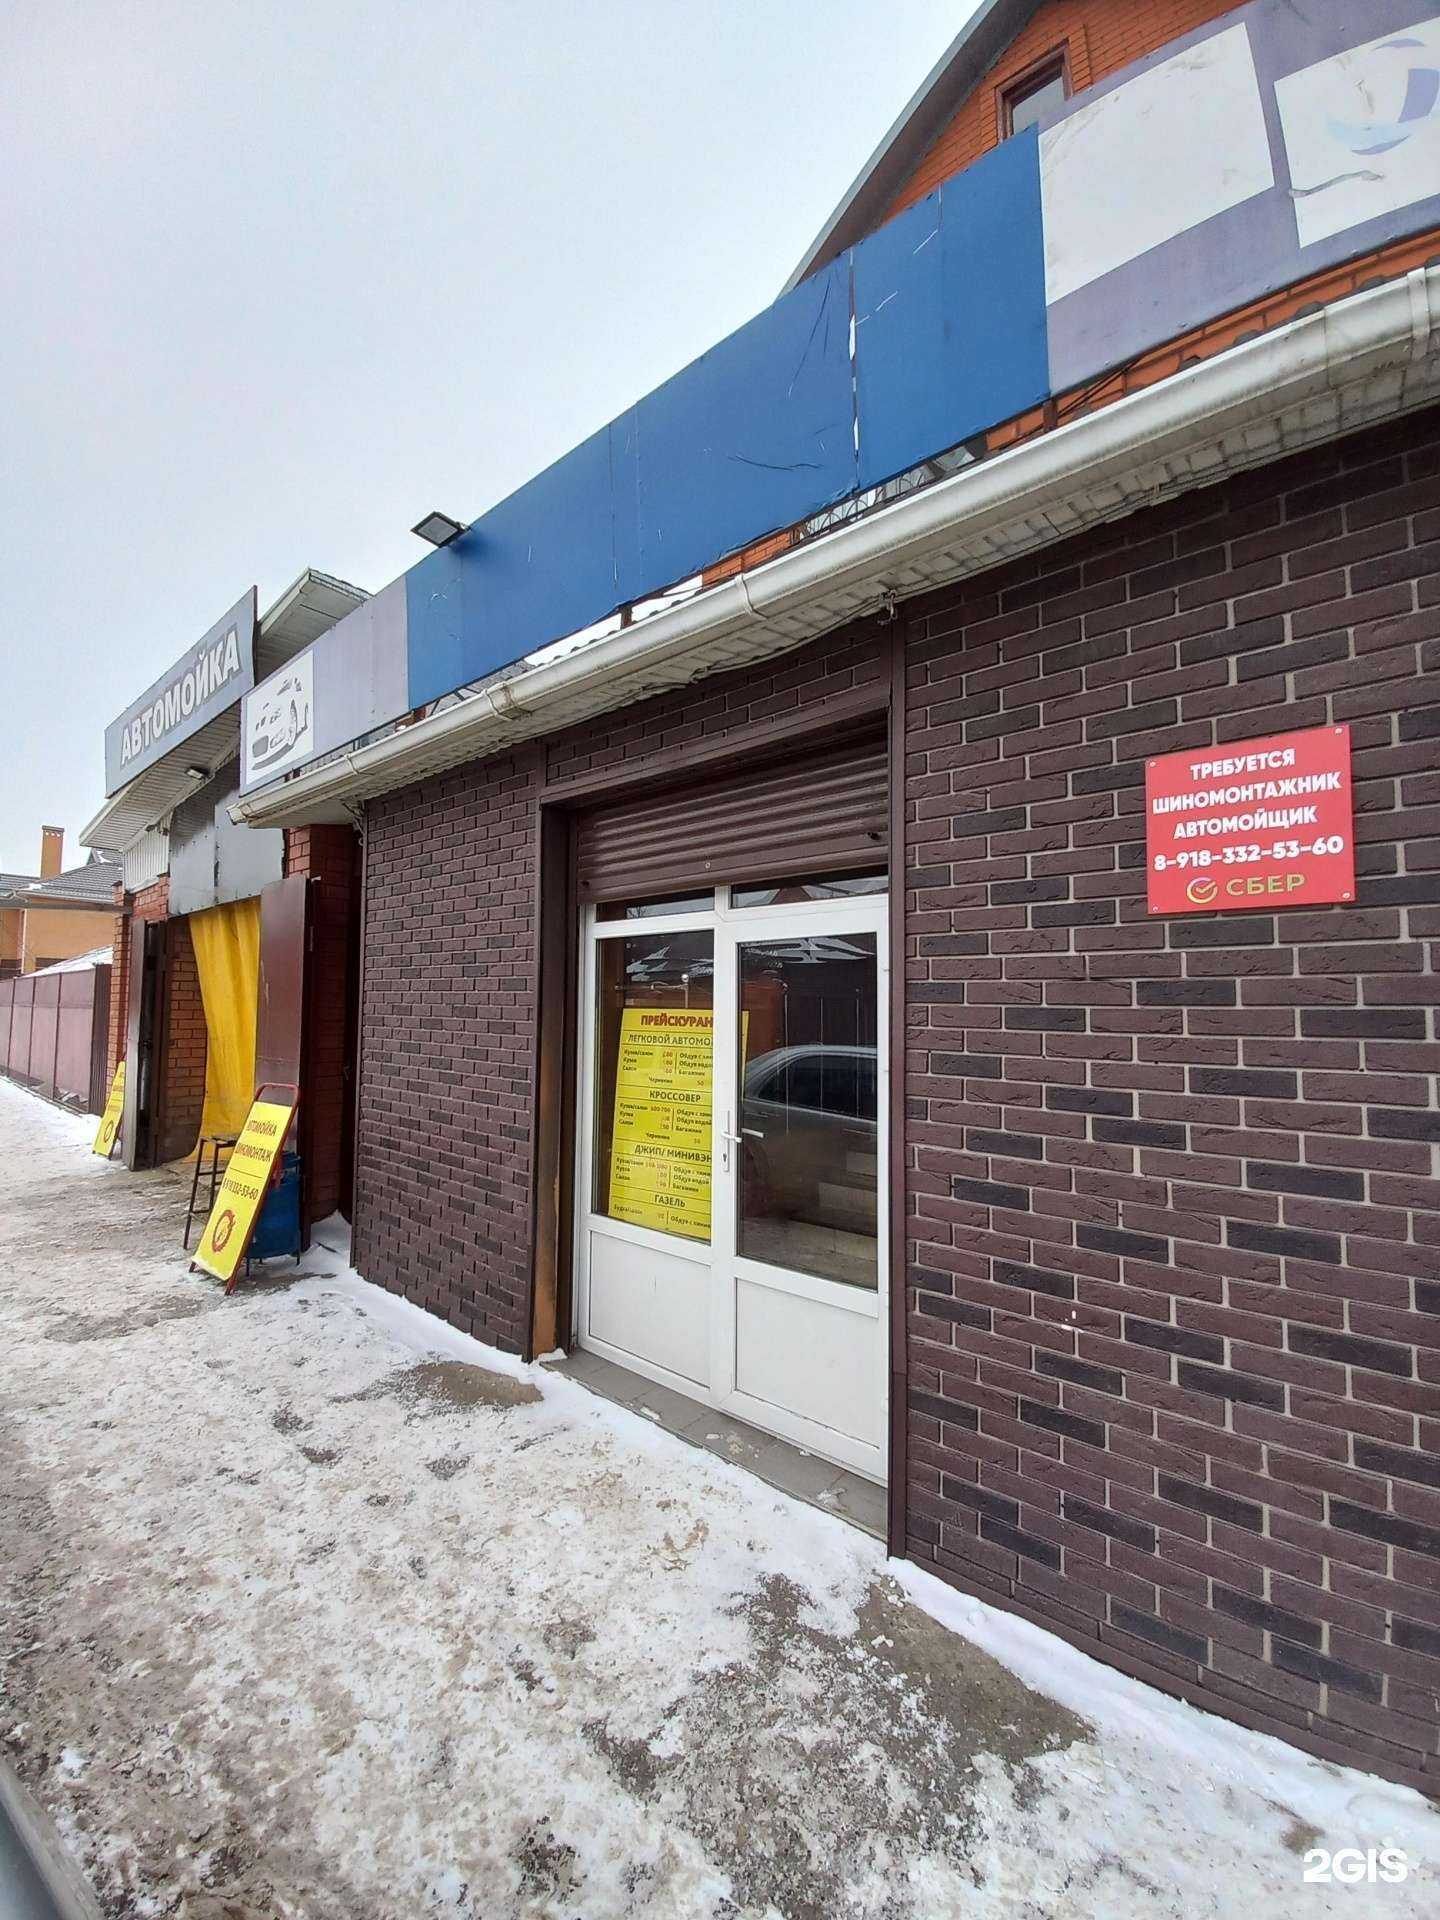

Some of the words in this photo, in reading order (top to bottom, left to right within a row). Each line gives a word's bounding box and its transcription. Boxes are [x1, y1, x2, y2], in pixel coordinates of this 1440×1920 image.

[121, 629, 240, 766] АВТОМОЙКА
[1190, 748, 1296, 781] ТРЕБУЕТСЯ
[1152, 771, 1342, 814] ШИНОМОНТАЖНИК
[1173, 805, 1318, 839] АВТОМОЙЩИК
[1154, 835, 1344, 871] 8-918-332-53-60
[1226, 873, 1305, 896] СБЕР
[628, 1033, 670, 1044] ЛЕГКОВОЙ
[672, 1036, 713, 1047] АВТОМО
[649, 1090, 701, 1102] КРОССОВЕР
[634, 1144, 665, 1156] ДЖИП/
[655, 1195, 686, 1207] ГАЗЕЛЬ
